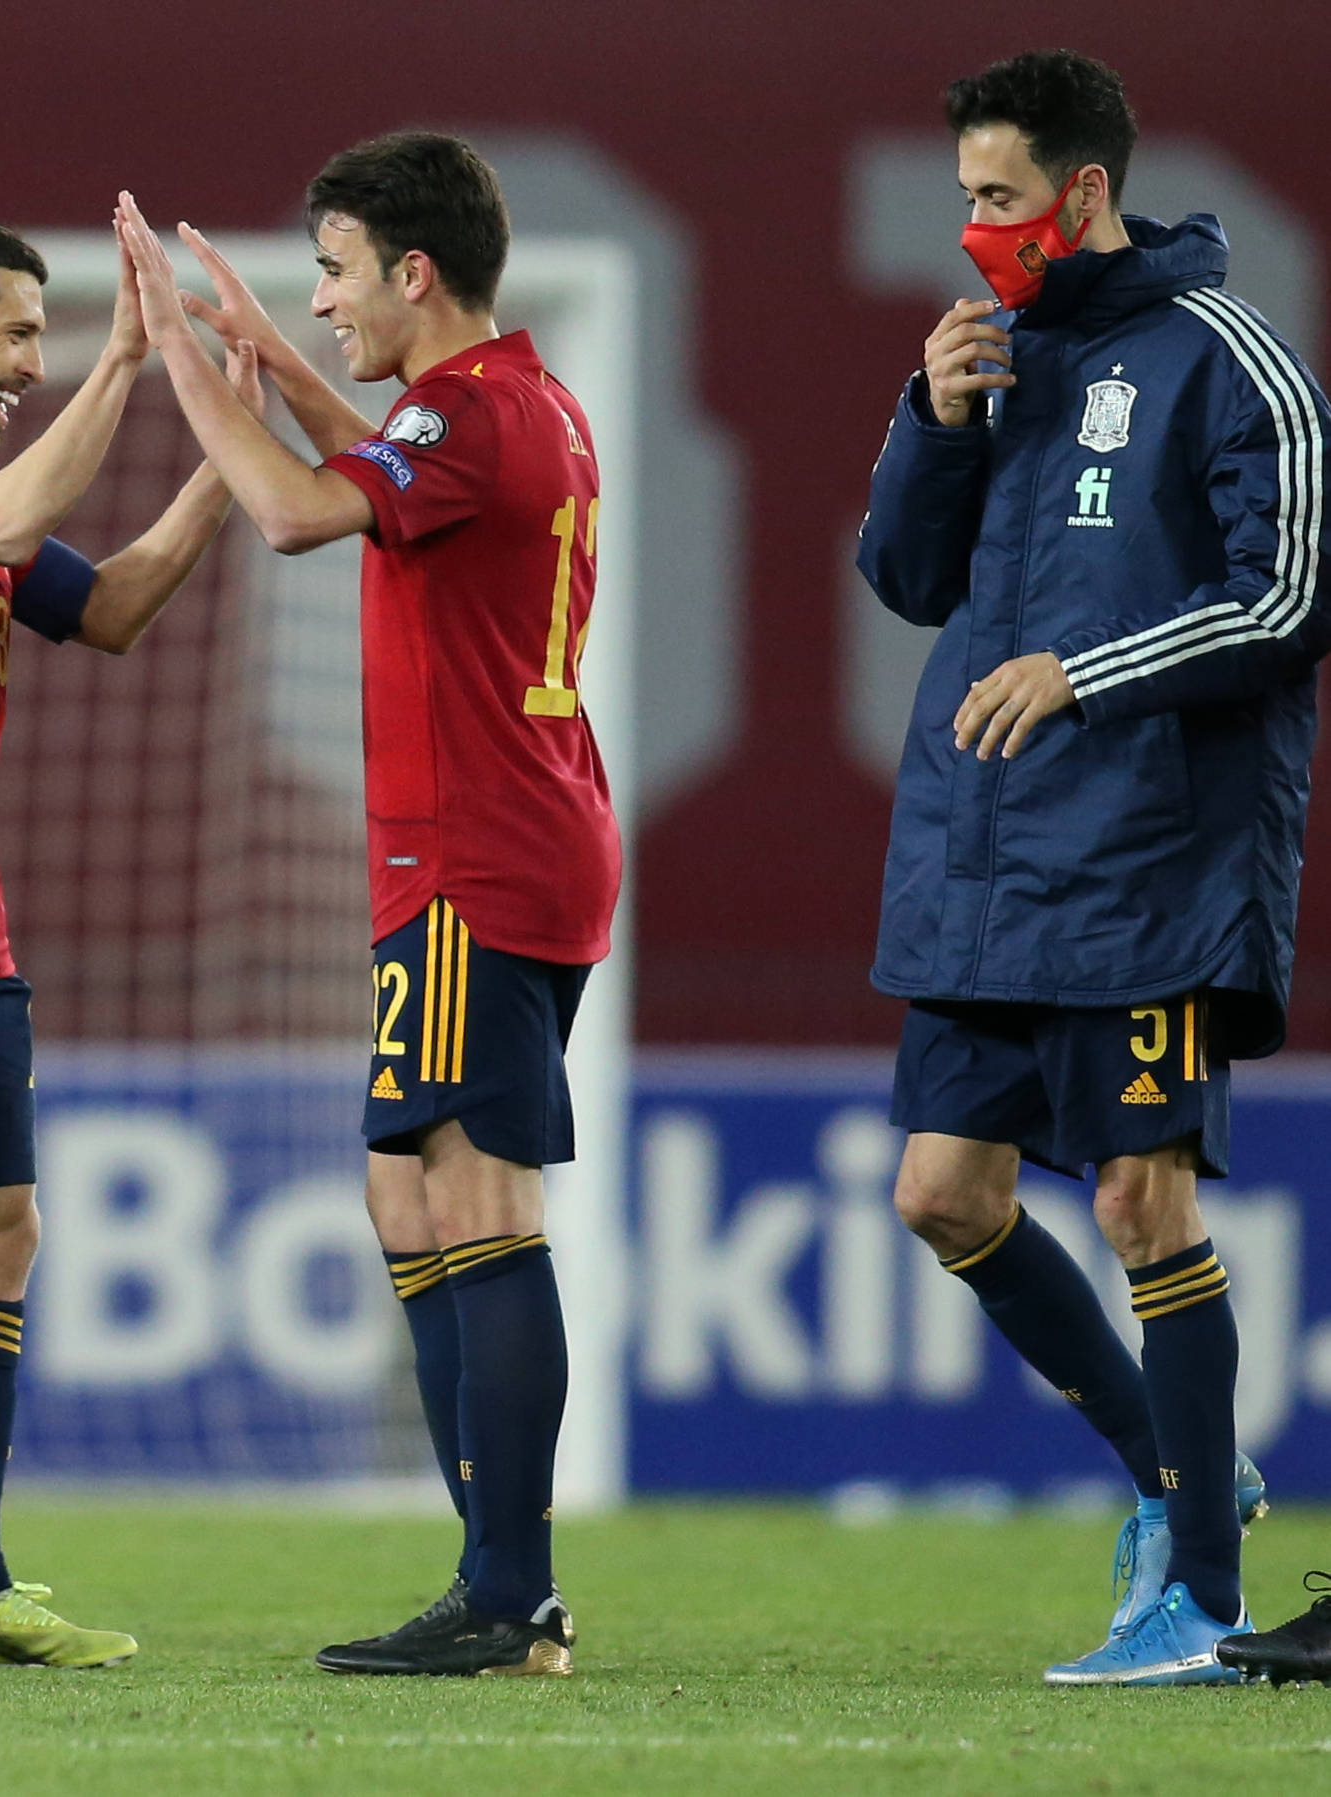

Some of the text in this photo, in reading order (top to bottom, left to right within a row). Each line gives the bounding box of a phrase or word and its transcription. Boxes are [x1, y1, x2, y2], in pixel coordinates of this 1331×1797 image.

[367, 445, 412, 485] RESPECT
[1075, 467, 1113, 515] fi
[1067, 515, 1114, 527] network
[371, 1087, 404, 1100] adidas
[1120, 1092, 1168, 1104] adidas
